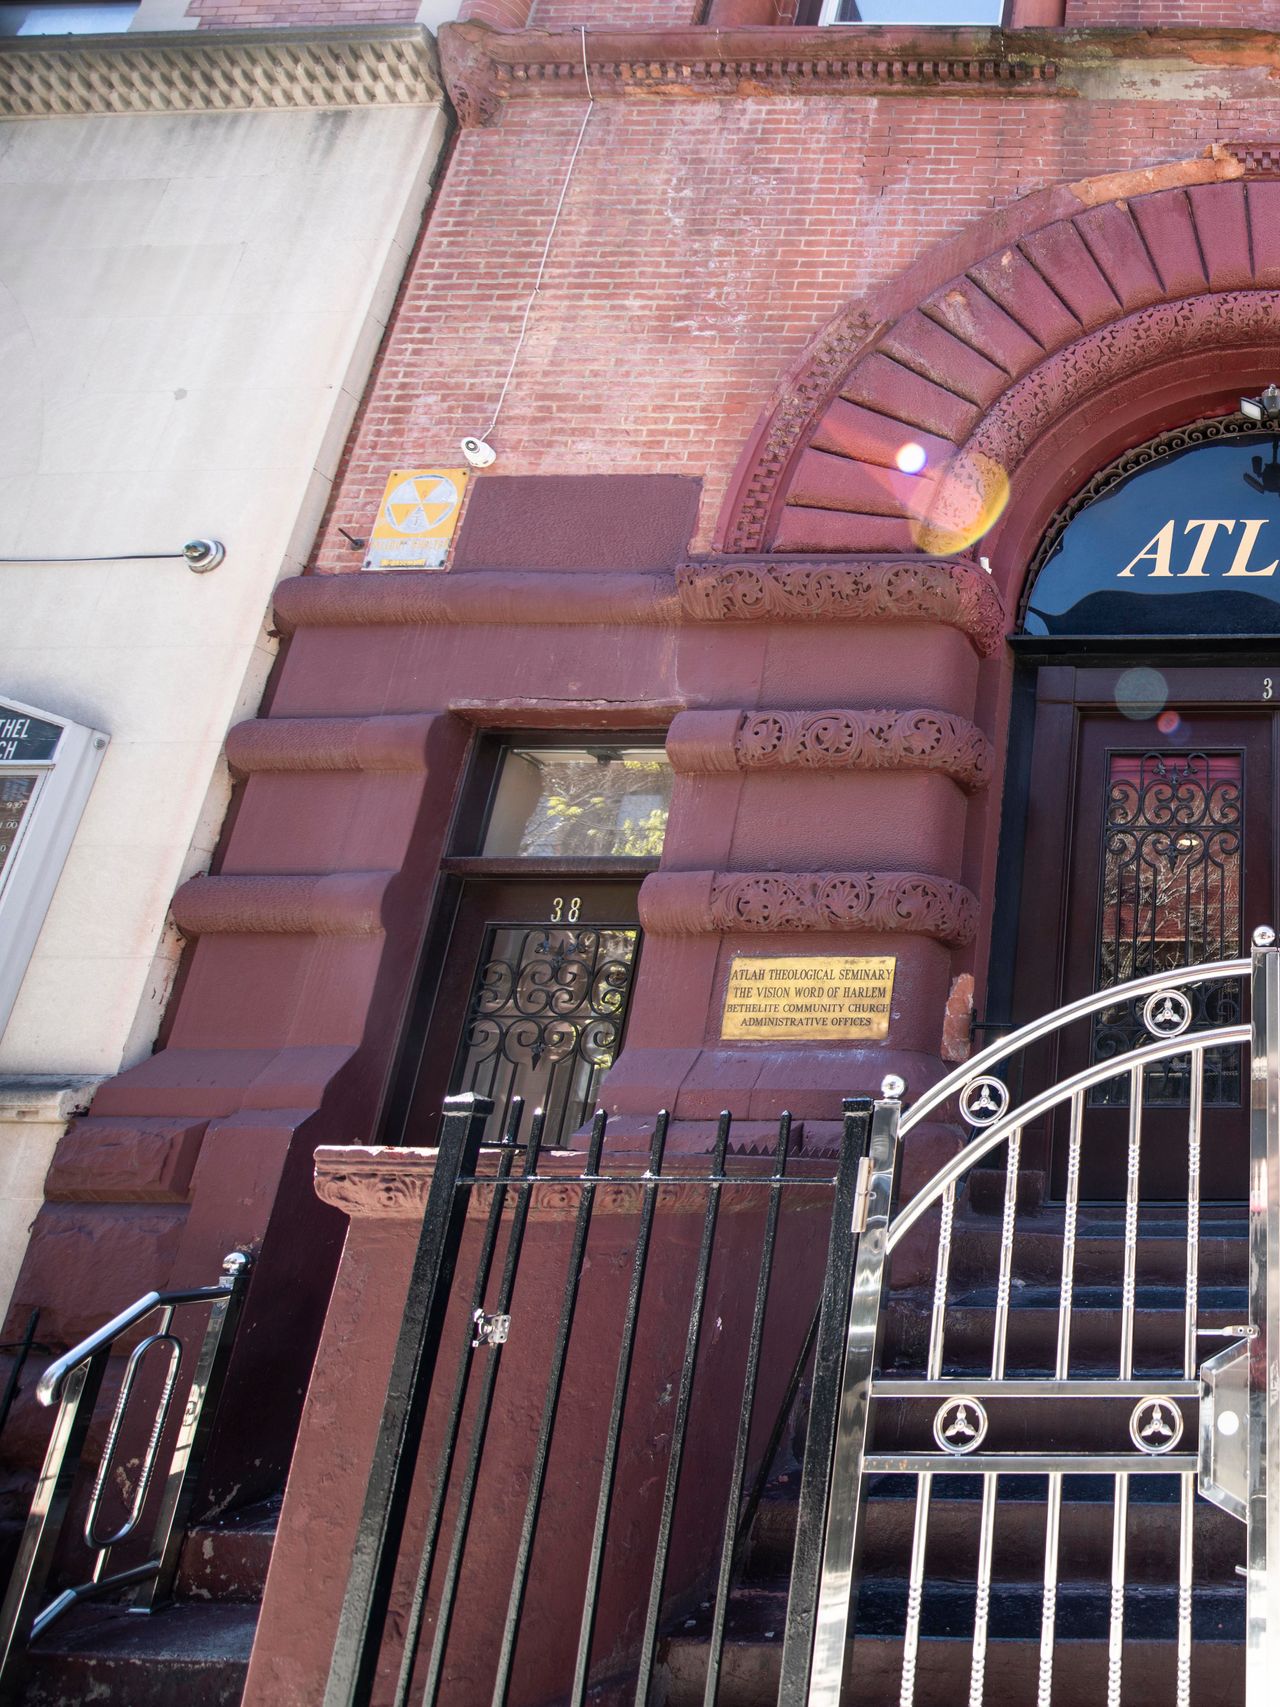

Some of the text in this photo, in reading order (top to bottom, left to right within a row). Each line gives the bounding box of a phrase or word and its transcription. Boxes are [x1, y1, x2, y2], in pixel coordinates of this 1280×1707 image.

[550, 897, 581, 922] 38
[731, 969, 893, 980] ATLAH THEOLOGICAL SEMINARY
[733, 987, 887, 998] THE VISION WORD OF HARLEM
[727, 1003, 890, 1013] BETHELITE COMMUNITY CHURCH
[740, 1017, 872, 1026] ADMINISTRATIVE OFFICES
